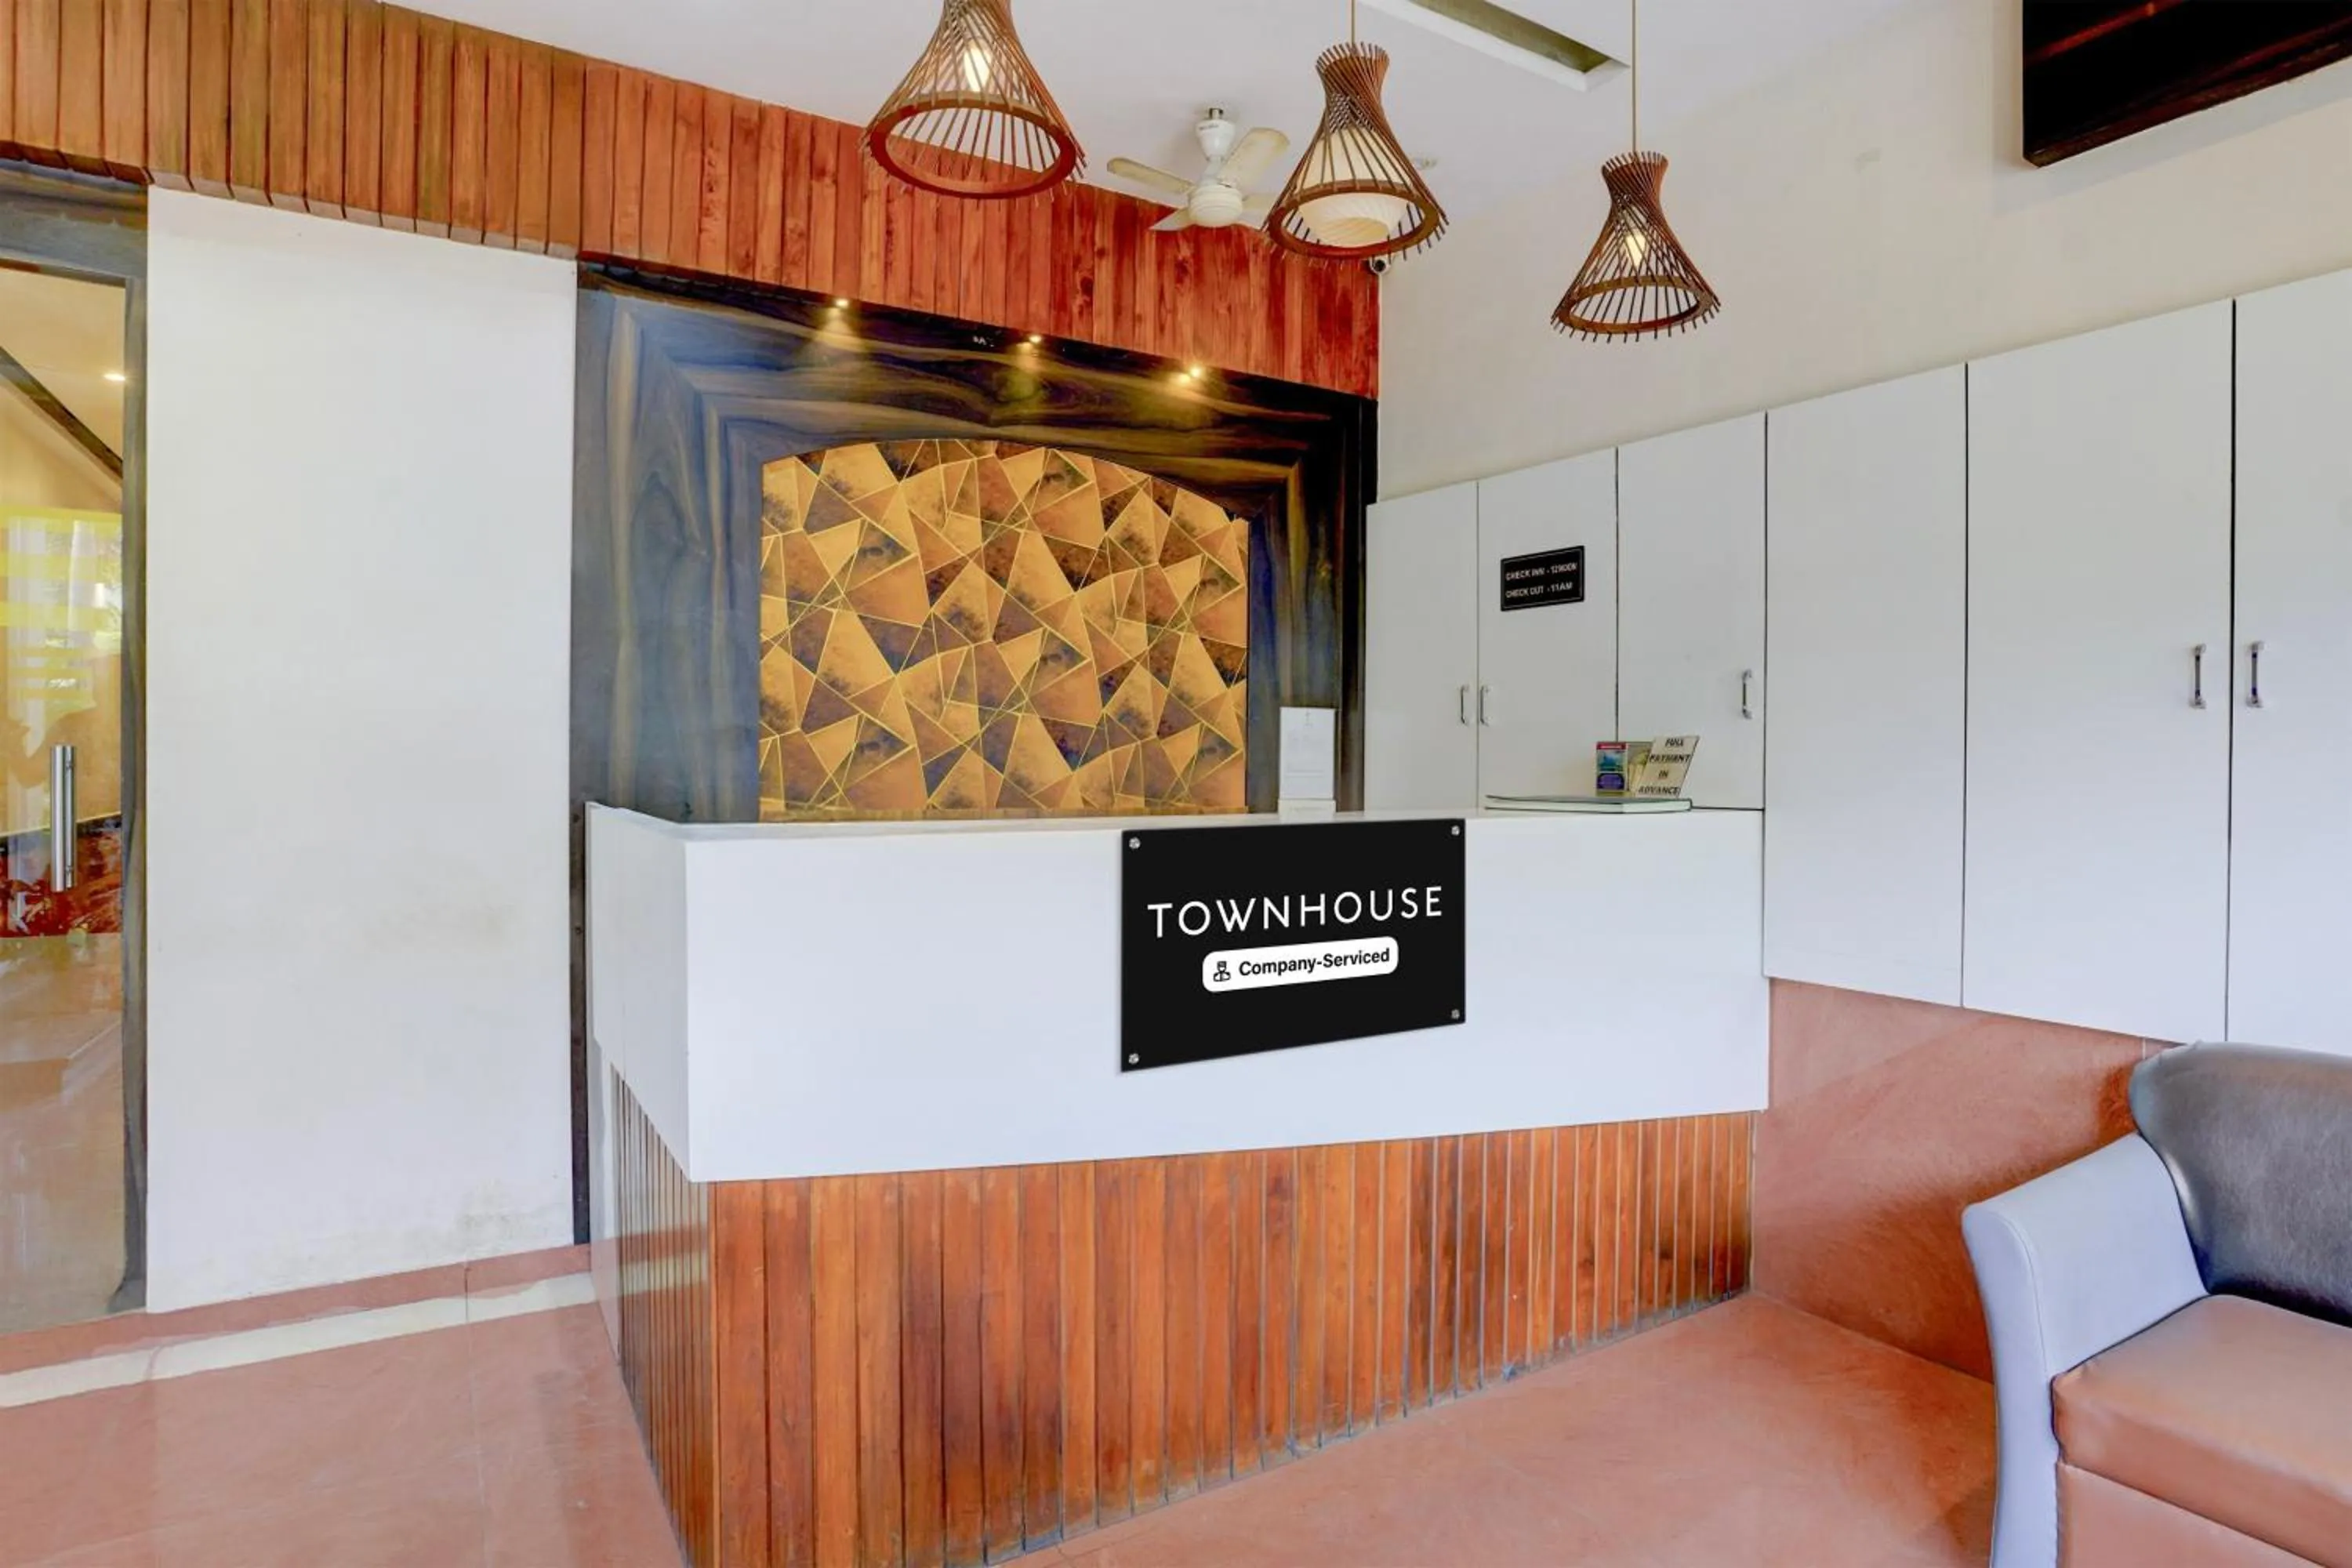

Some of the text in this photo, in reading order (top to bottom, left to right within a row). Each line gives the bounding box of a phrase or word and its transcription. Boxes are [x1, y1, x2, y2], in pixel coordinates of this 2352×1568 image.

[1505, 569, 1530, 580] CHECK
[1505, 588, 1529, 598] CHECK
[1530, 586, 1544, 595] OUT
[1551, 581, 1573, 592] 11AM
[1147, 886, 1443, 938] TOWNHOUSE
[1239, 948, 1390, 977] Company-Serviced
